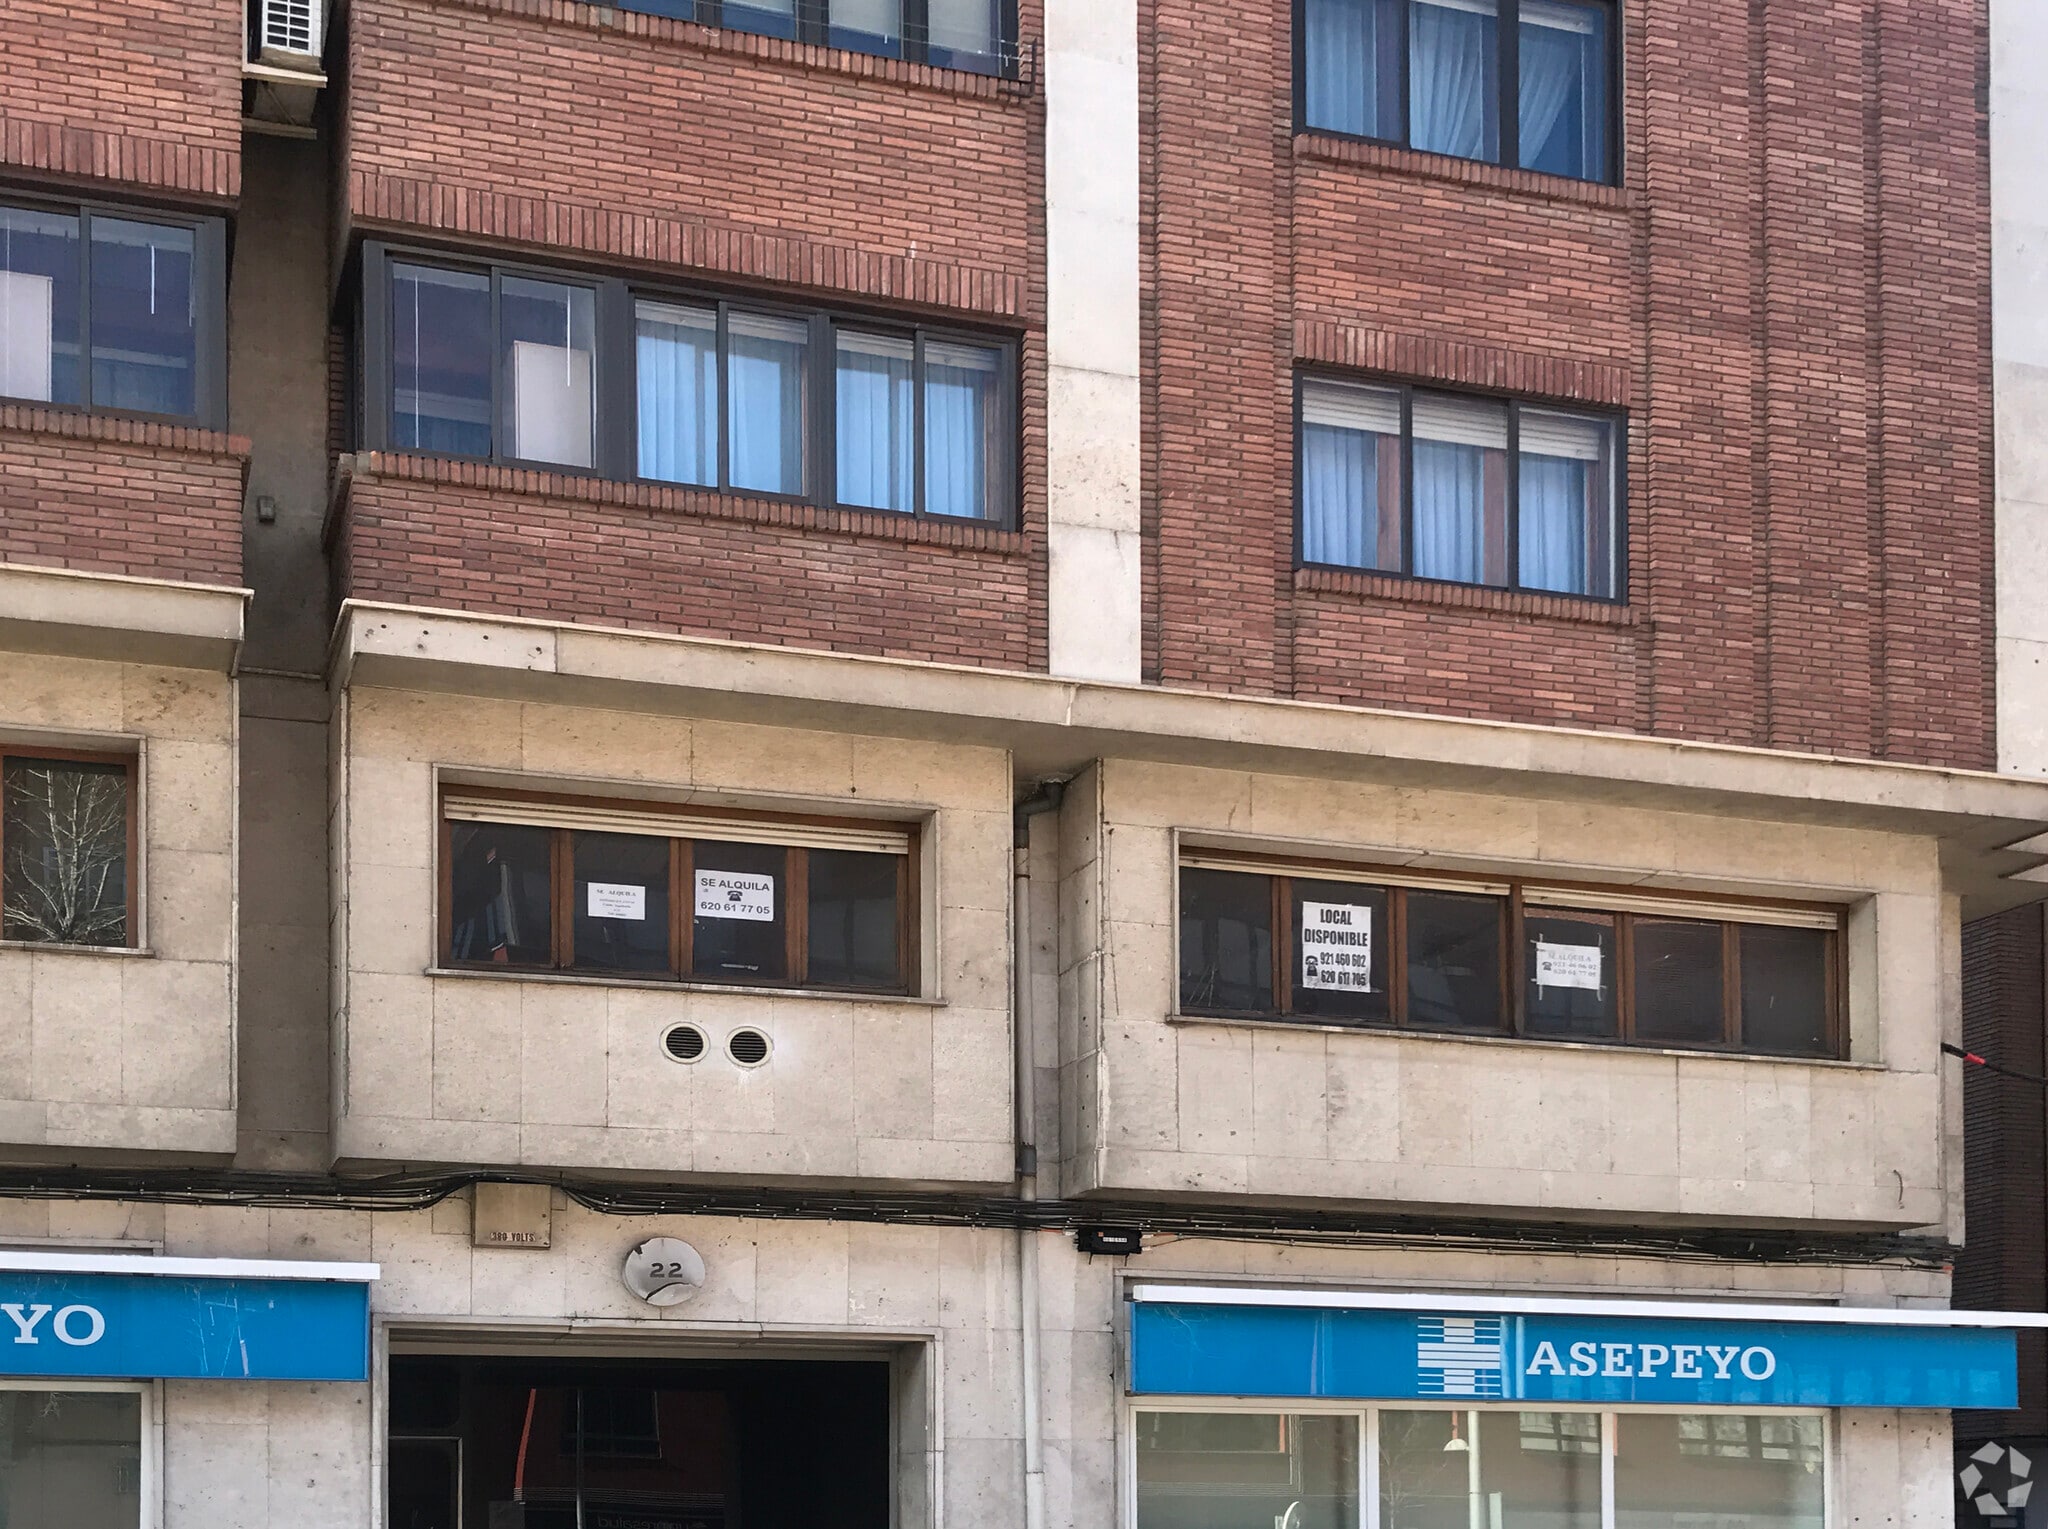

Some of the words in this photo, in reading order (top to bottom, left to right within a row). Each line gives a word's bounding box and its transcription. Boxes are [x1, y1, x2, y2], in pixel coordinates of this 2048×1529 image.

[700, 877, 716, 887] SE
[718, 879, 770, 891] ALQUILA
[700, 901, 721, 911] 620
[723, 903, 736, 912] 61
[740, 904, 754, 913] 77
[756, 905, 770, 914] 05
[1320, 909, 1352, 925] LOCAL
[1304, 928, 1368, 947] DISPONIBLE
[1320, 951, 1334, 965] 921
[1321, 969, 1336, 984] 620
[1338, 971, 1350, 985] 617
[1352, 972, 1366, 986] 705
[511, 1232, 535, 1243] VOLTS
[649, 1262, 684, 1279] 22
[0, 1303, 106, 1346] YO
[1525, 1340, 1777, 1381] ASEPEYO
